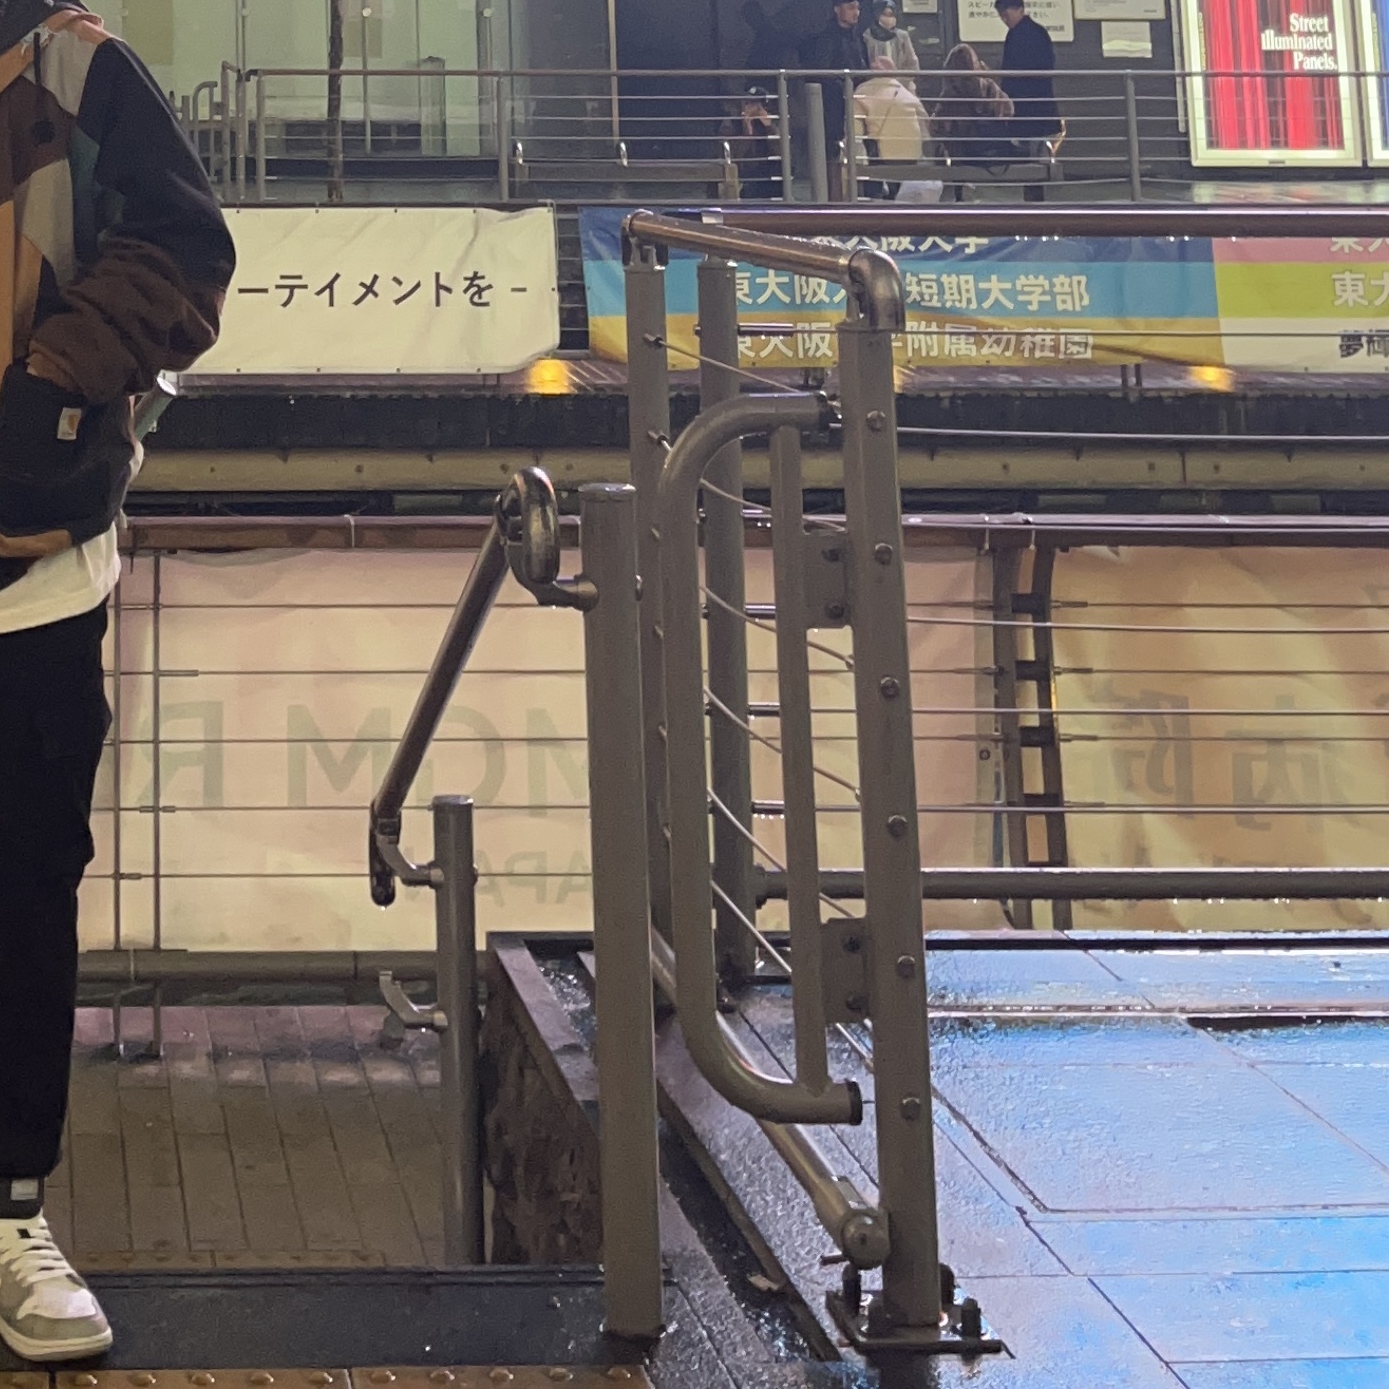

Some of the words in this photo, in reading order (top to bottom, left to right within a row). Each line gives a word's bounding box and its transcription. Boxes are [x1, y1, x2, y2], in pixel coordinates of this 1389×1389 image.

[1290, 12, 1330, 33] Street
[1293, 51, 1338, 70] Panels.
[237, 270, 494, 308] ーテイメントを
